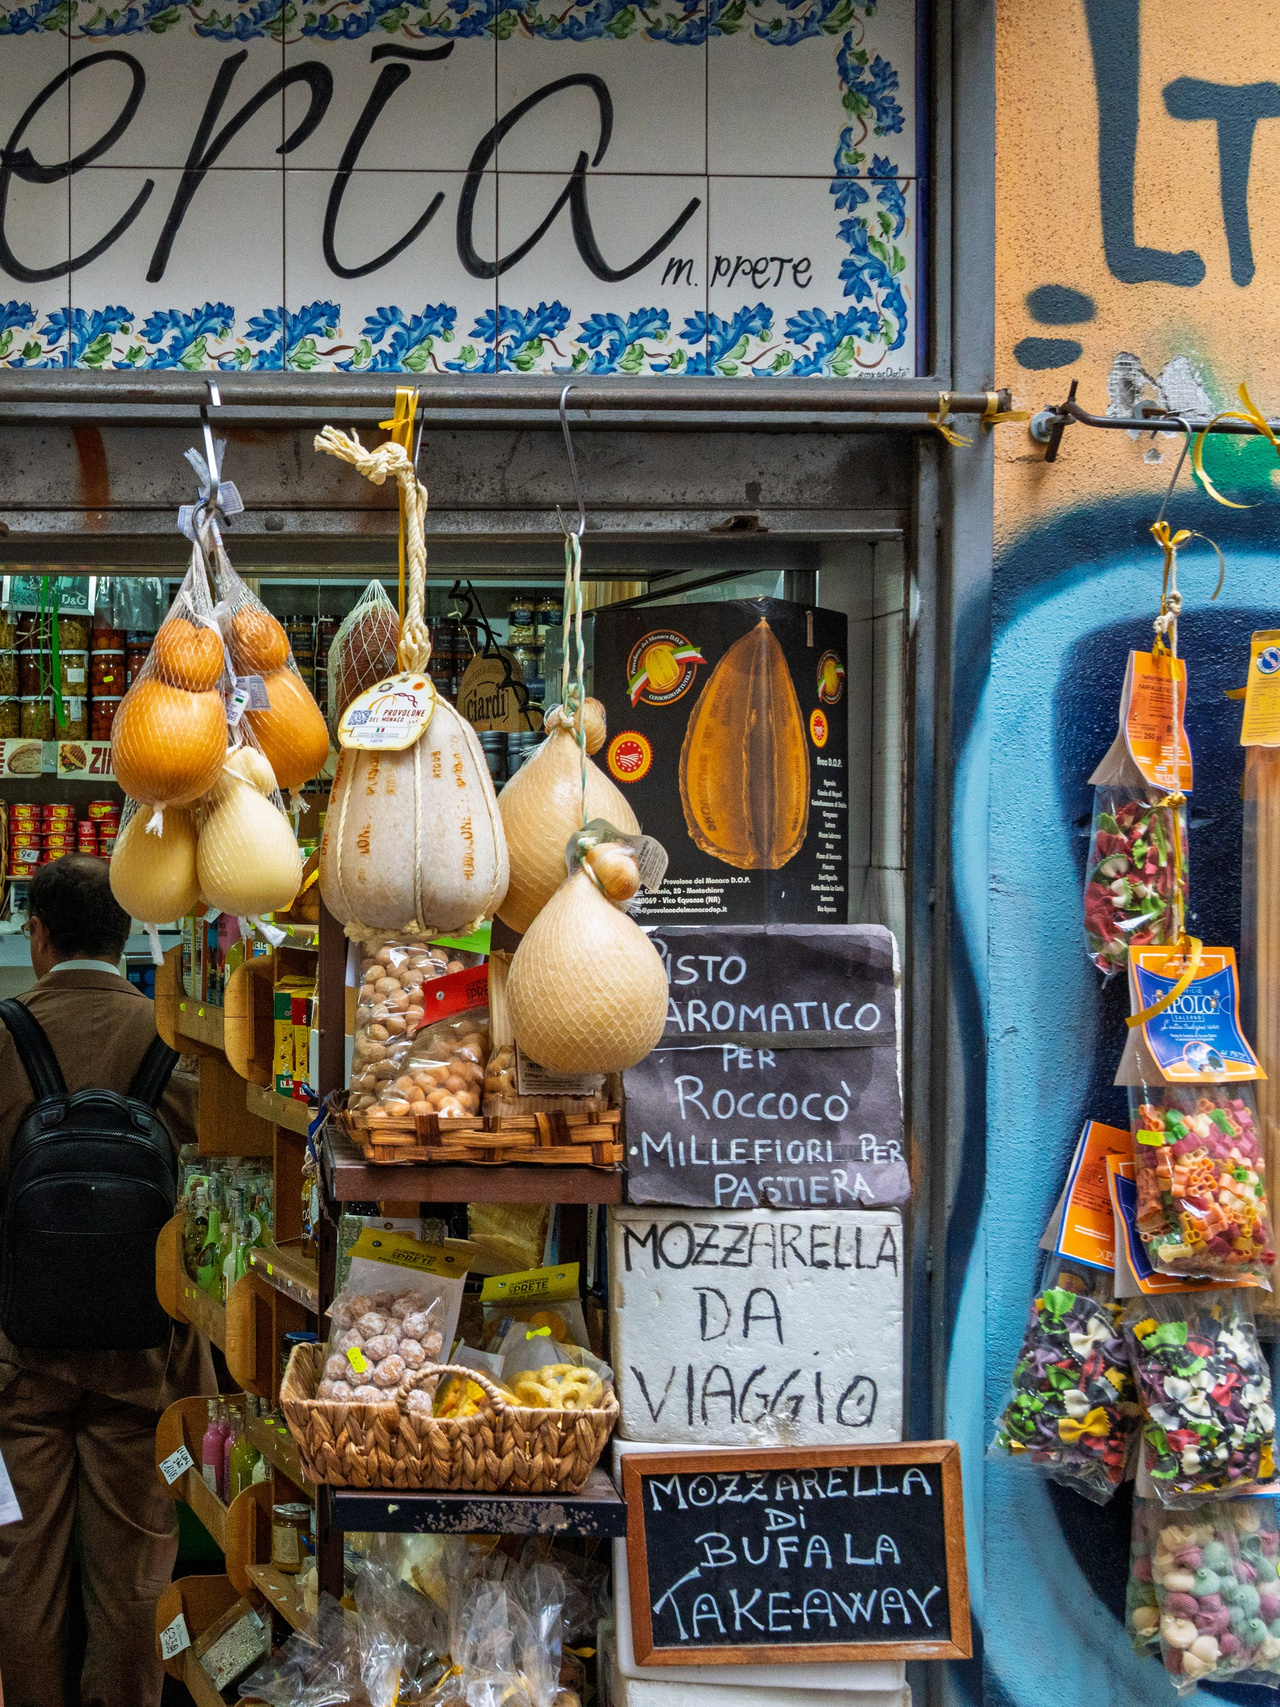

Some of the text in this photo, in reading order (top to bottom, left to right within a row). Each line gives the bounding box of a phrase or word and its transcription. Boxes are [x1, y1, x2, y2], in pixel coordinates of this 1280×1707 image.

[62, 594, 87, 605] D&G
[649, 691, 676, 700] CONSORZIO
[681, 670, 692, 688] TUTELA
[383, 709, 426, 717] PROVOLONE
[1144, 732, 1155, 740] 250
[694, 877, 705, 885] del
[706, 877, 729, 885] Monaco
[730, 876, 751, 884] D.O.P.
[677, 897, 705, 906] Equense
[705, 896, 721, 905] (NA)
[470, 984, 488, 1000] PRE
[666, 999, 881, 1032] AROMATICO
[723, 1046, 776, 1072] PER
[859, 1133, 905, 1165] PER
[714, 1169, 875, 1207] PASTIERA
[396, 1253, 436, 1265] PRETE
[623, 1221, 899, 1277] MOZZARELLA
[513, 1282, 549, 1294] PRETE
[693, 1287, 784, 1345] DA
[630, 1350, 879, 1428] VIAGGIO
[648, 1466, 934, 1511] MOZZARELLA
[695, 1533, 901, 1570] BUFALA
[653, 1567, 942, 1640] TAKE-AWAY
